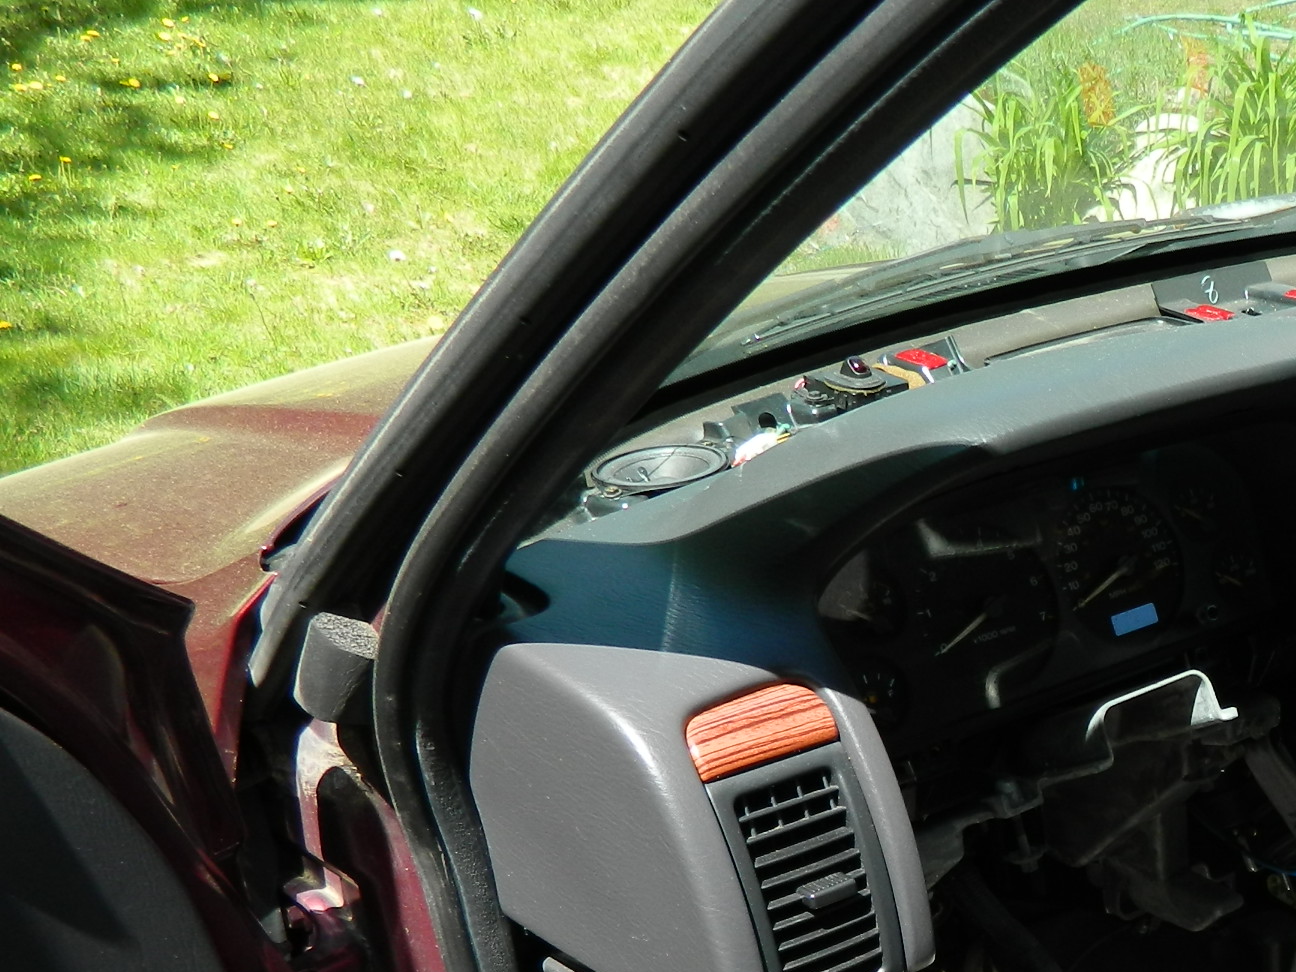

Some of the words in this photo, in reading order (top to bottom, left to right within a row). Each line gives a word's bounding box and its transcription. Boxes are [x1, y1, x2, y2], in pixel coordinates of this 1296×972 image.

[1089, 502, 1103, 513] 60
[1104, 500, 1119, 511] 70
[1120, 505, 1135, 517] 80
[1076, 512, 1091, 524] 50
[1066, 526, 1081, 537] 40
[1141, 527, 1158, 539] 100
[1062, 543, 1078, 554] 30
[1151, 541, 1167, 552] 110
[1063, 561, 1079, 573] 20
[1152, 558, 1171, 570] 120
[1069, 581, 1080, 591] 10
